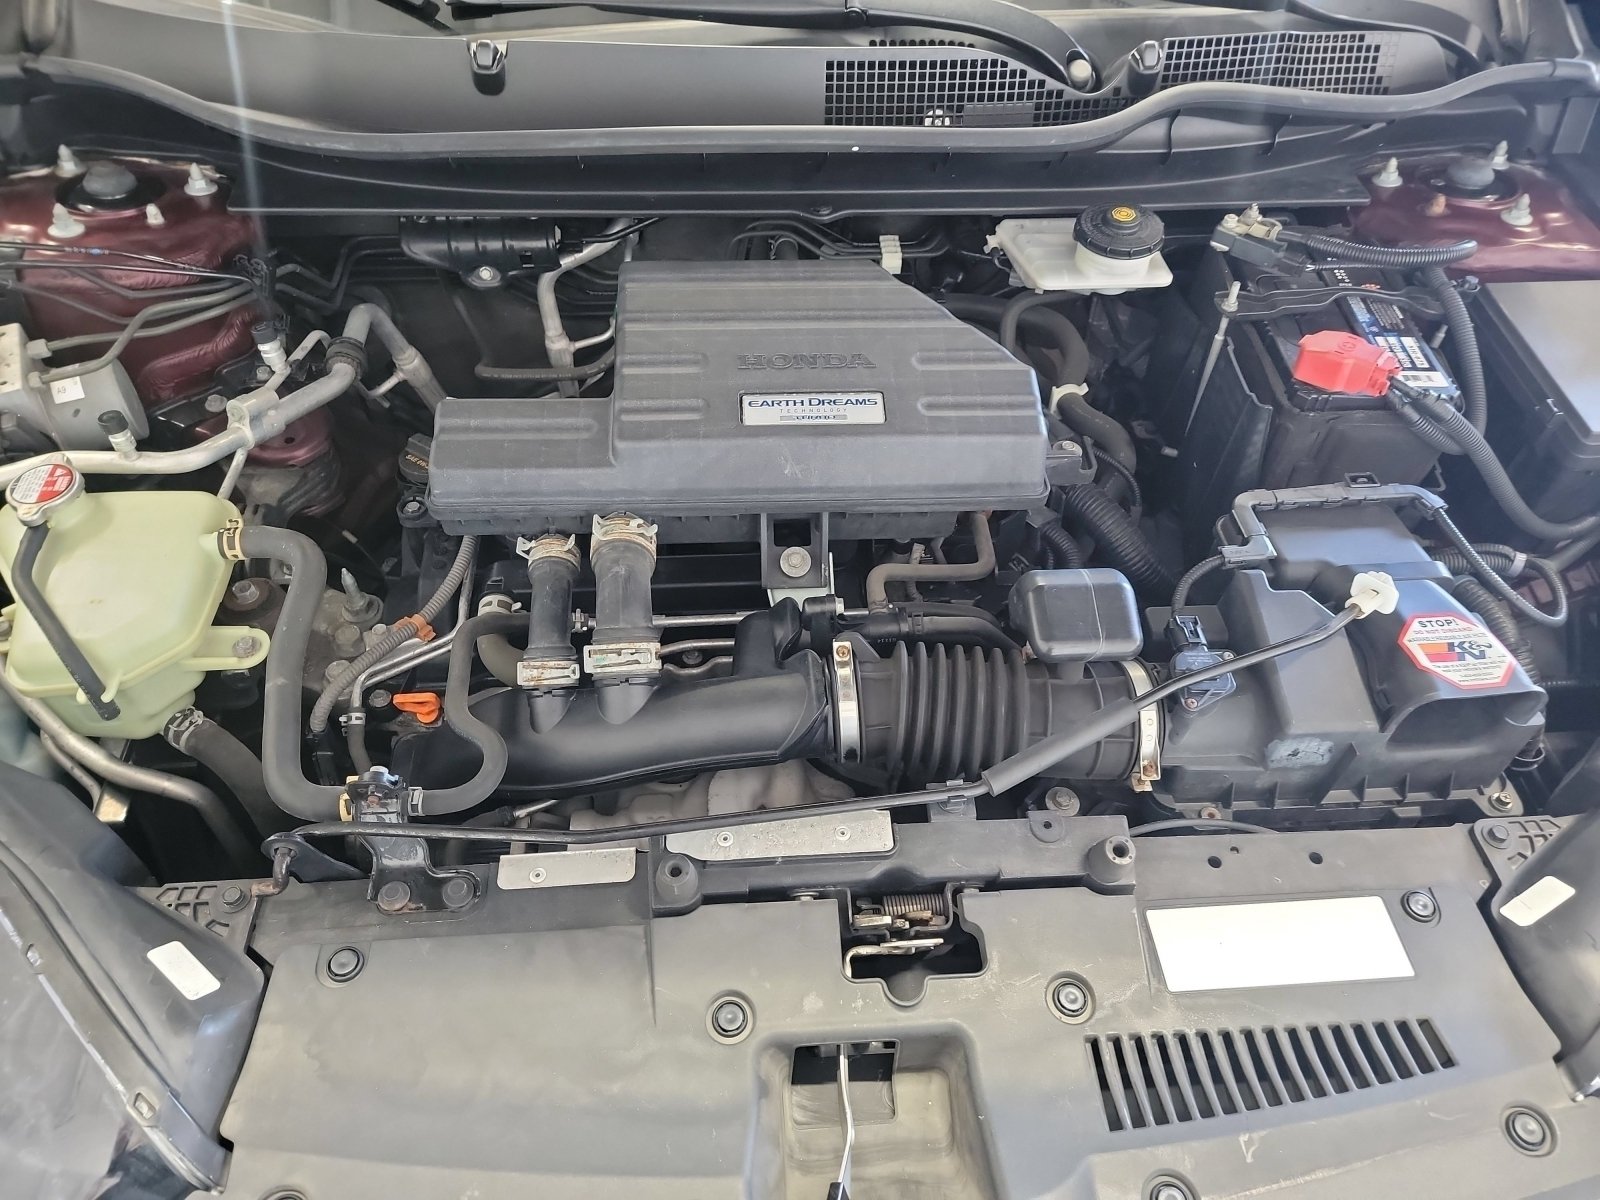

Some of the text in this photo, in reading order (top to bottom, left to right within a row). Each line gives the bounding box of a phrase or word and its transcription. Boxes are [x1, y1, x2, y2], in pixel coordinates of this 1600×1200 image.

[737, 352, 876, 370] HONDA
[748, 397, 878, 408] EARTH DREAMS
[1417, 618, 1459, 628] STOP!
[1447, 640, 1493, 662] K&N
